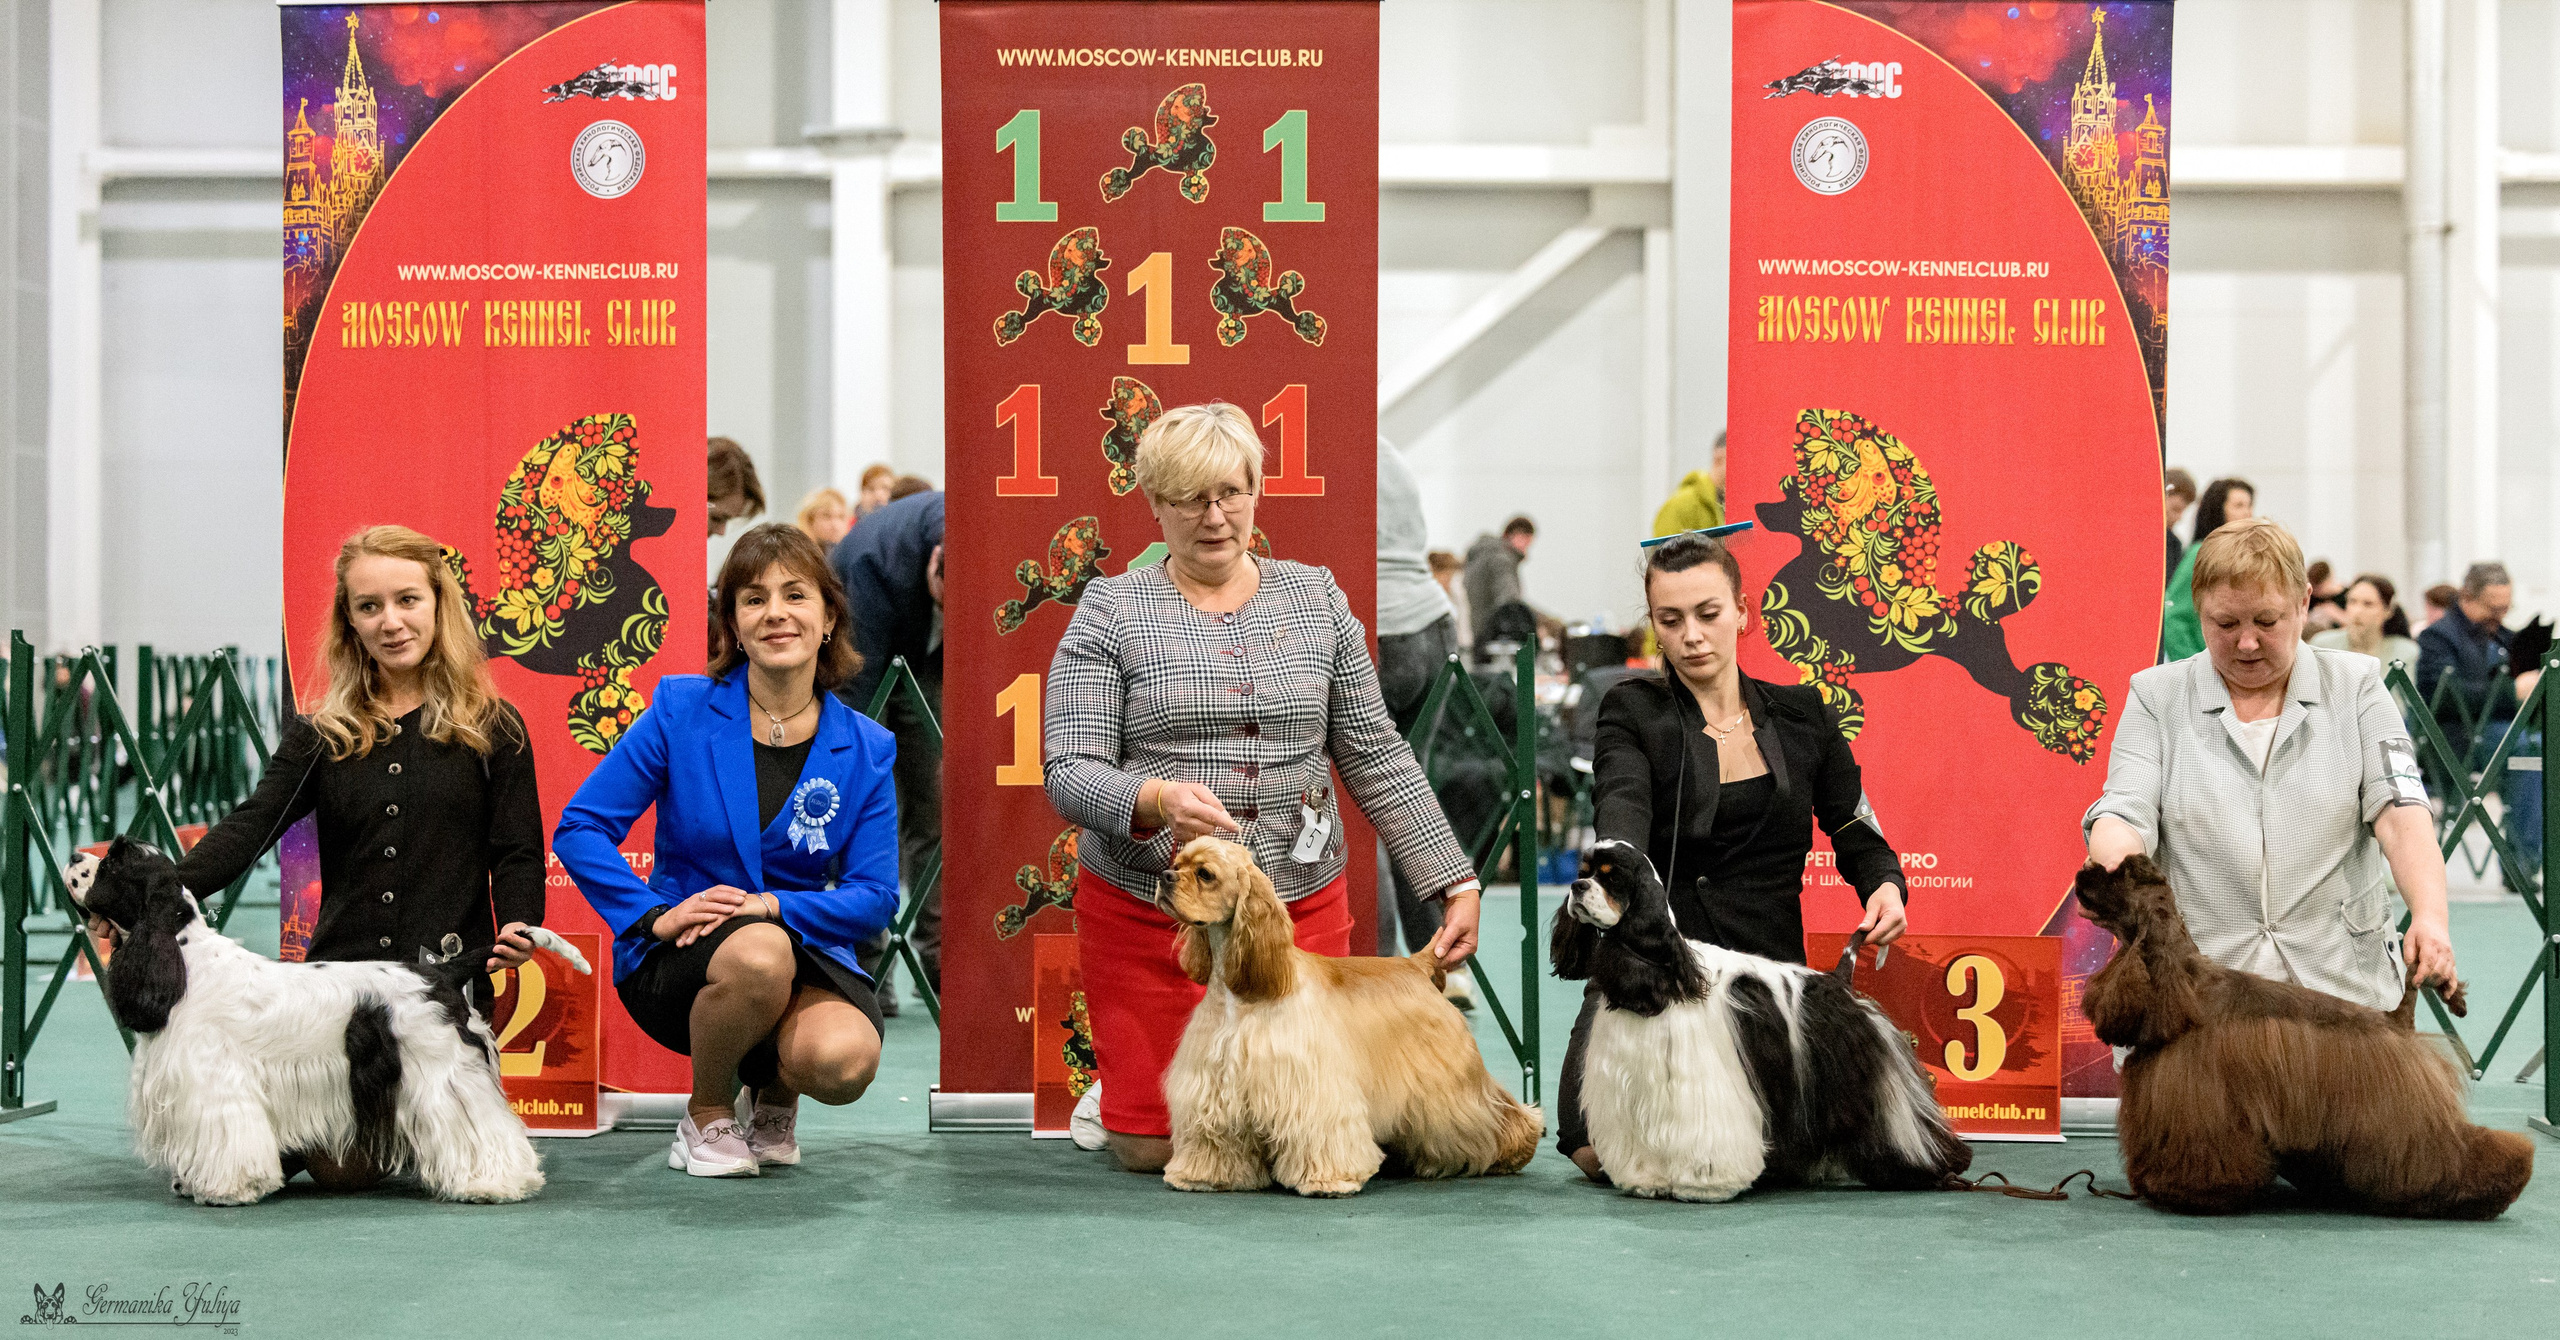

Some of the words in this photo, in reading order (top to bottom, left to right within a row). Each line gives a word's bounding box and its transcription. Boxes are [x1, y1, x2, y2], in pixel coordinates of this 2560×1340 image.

[997, 48, 1324, 67] WWW.MOSCOW-KENNELCLUB.RU
[580, 125, 638, 149] КИНОЛОГИЧЕСКАЯ
[1801, 121, 1861, 147] КИНОЛОГИЧЕСКАЯ
[574, 147, 600, 192] РОССИЙСКАЯ
[616, 150, 641, 192] ФЕДЕРАЦИЯ
[996, 109, 1058, 222] 1
[1263, 109, 1325, 222] 1
[1794, 143, 1821, 188] РОССИЙСКАЯ
[1839, 147, 1864, 188] ФЕДЕРАЦИЯ
[398, 263, 678, 281] WWW.MOSCOW-KENNELCLUB.RU
[1758, 258, 2049, 278] WWW.MOSCOW-KENNELCLUB.RU
[341, 300, 469, 348] MOSCOW
[484, 299, 591, 347] KENNEL
[1127, 252, 1190, 365] 1
[1757, 295, 1890, 343] MOSCOW
[1906, 297, 2015, 345] KENNEL
[996, 384, 1058, 496] 1
[1263, 384, 1325, 496] 1
[996, 673, 1045, 786] 1
[1306, 828, 1321, 848] 5
[490, 959, 546, 1077] 2
[1944, 954, 2007, 1082] 3
